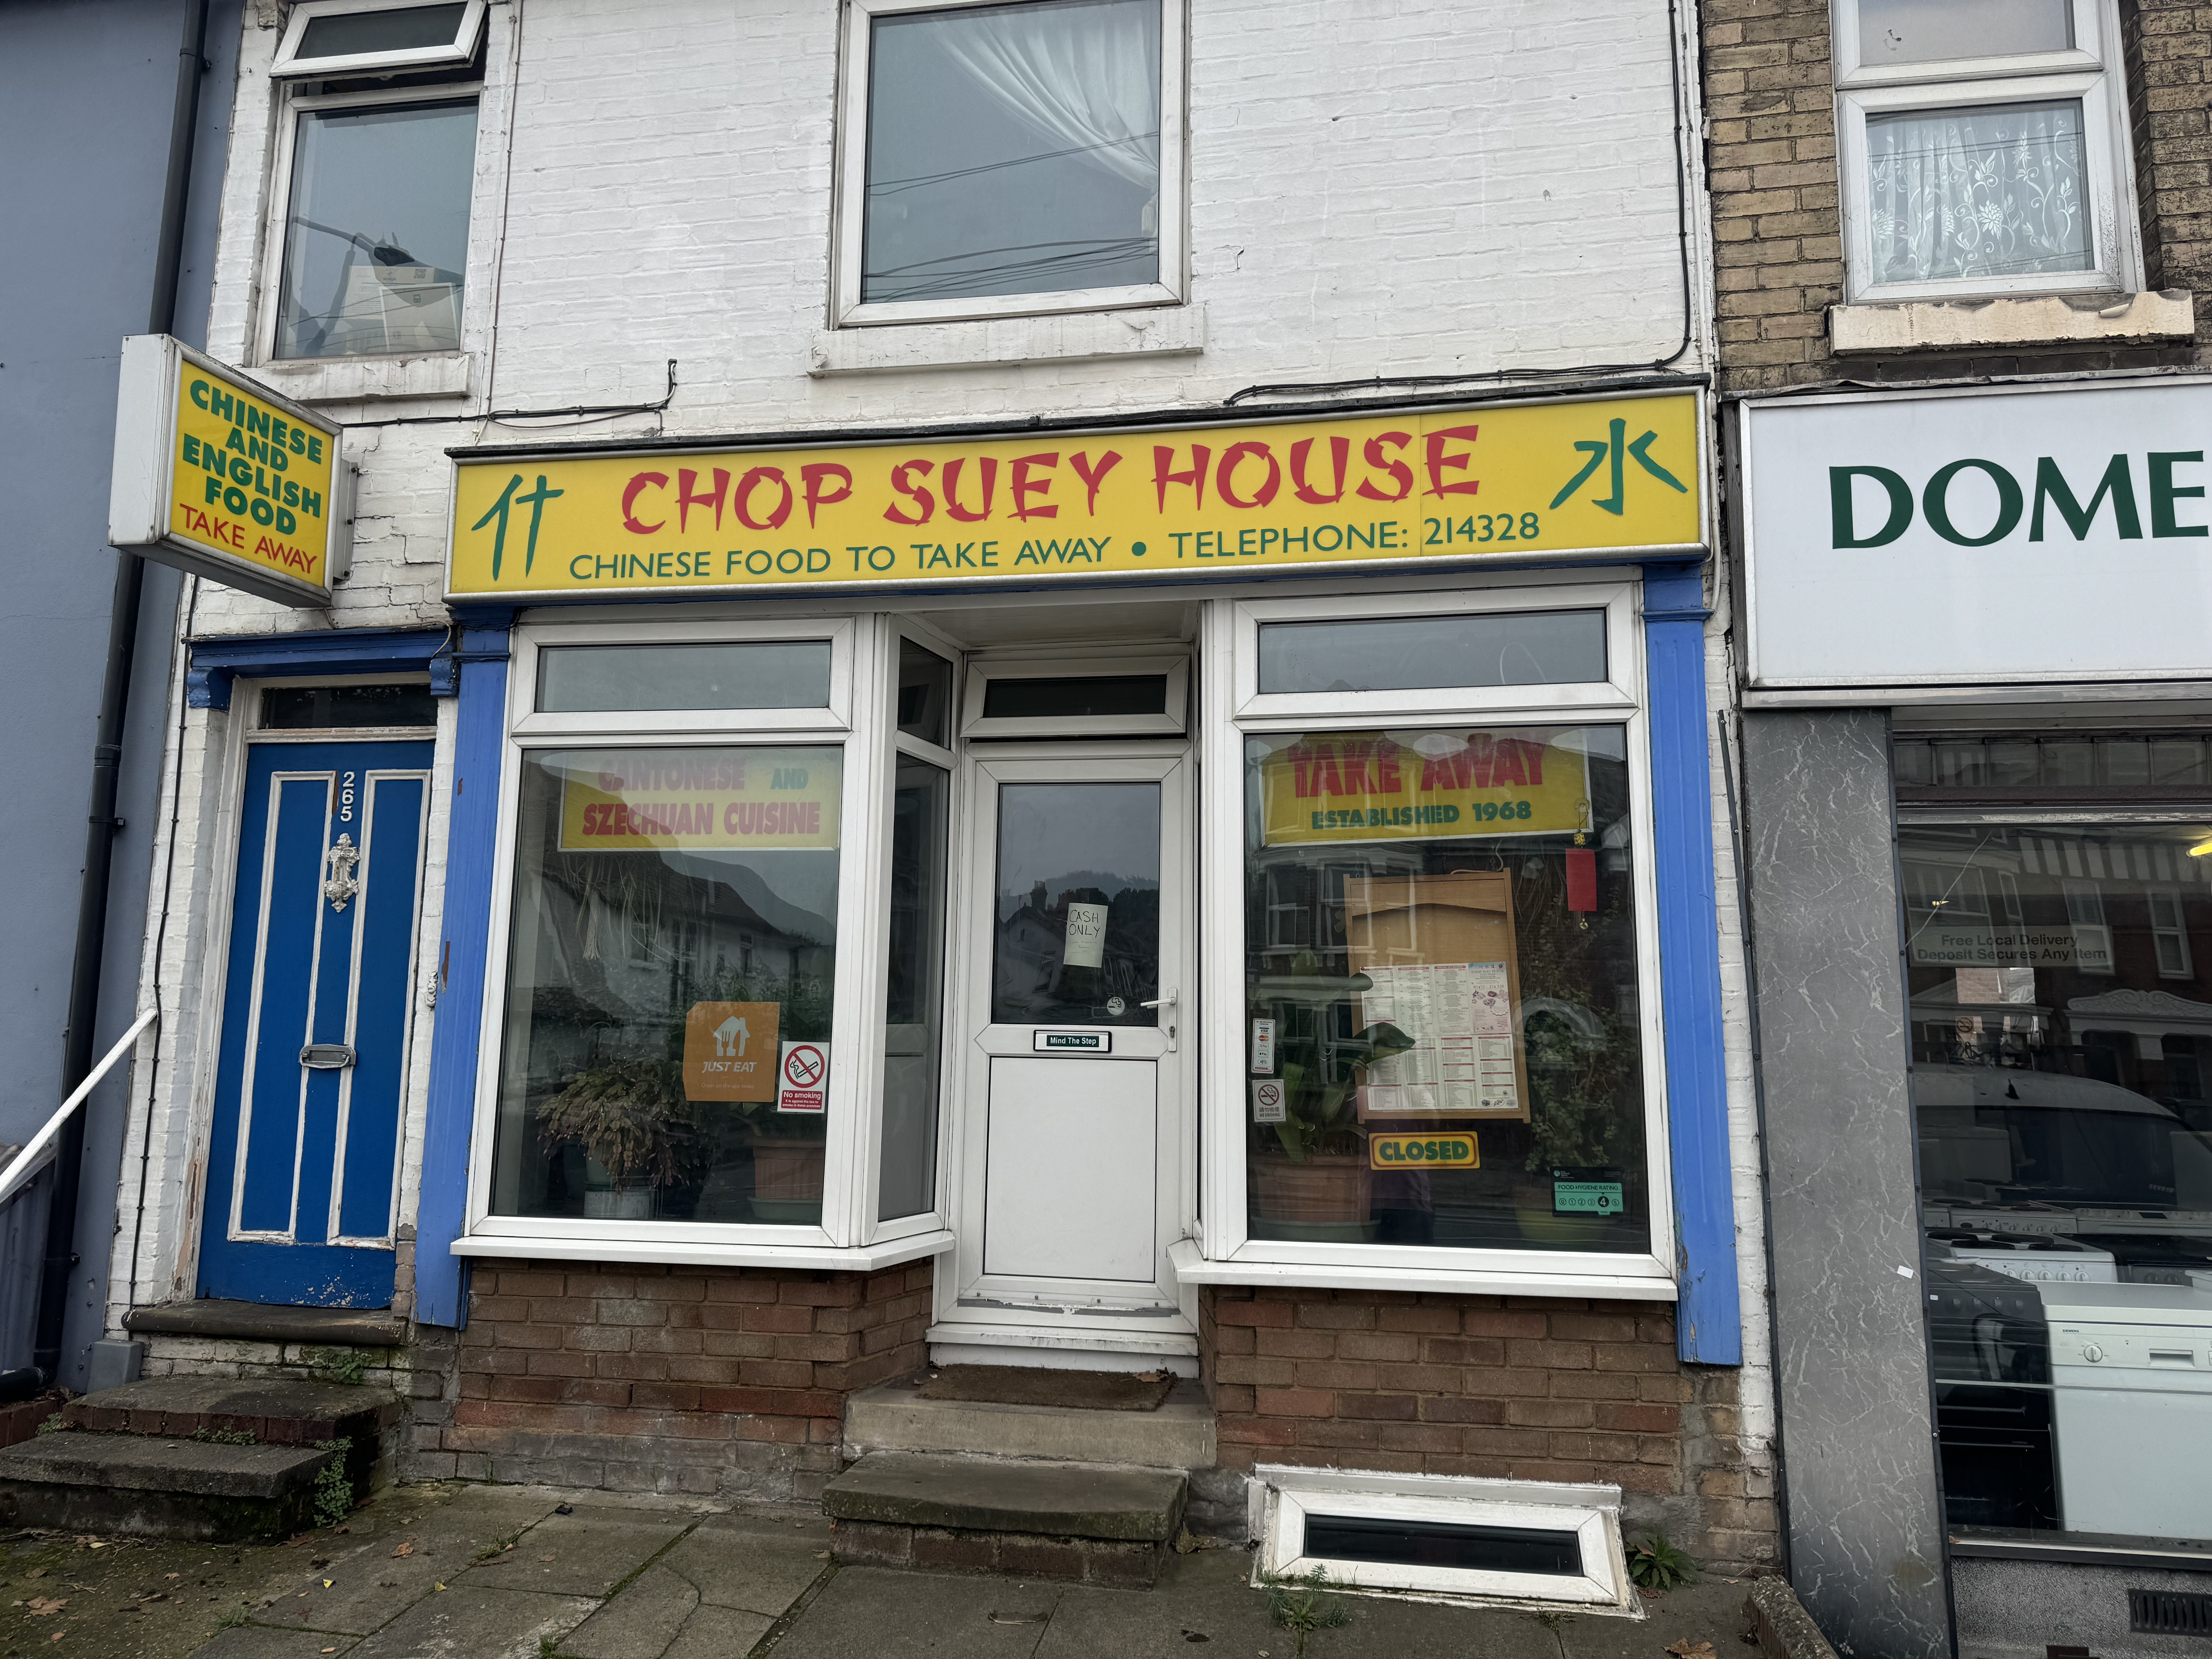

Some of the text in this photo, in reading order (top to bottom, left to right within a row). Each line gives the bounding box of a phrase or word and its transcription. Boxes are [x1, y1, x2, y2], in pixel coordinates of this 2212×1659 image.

[190, 380, 322, 464] CHINESE
[225, 427, 288, 471] AND
[182, 433, 321, 518] ENGLISH
[622, 425, 1479, 534] CHOP SUEY HOUSE
[1549, 418, 1688, 516] 水
[205, 476, 296, 535] FOOD
[1829, 450, 2209, 550] DOME
[180, 503, 317, 574] TAKE AWAY
[570, 512, 1540, 580] CHINESE FOOD TO TAKE AWAY TELEPHONE: 214328
[598, 758, 809, 792] CANTONESE AND
[1287, 735, 1546, 798] TAKE AWAY
[582, 802, 821, 835] SZECHUAN CUISINE
[1312, 801, 1532, 830] ESTABLISHED 1968
[1069, 909, 1099, 924] CASH
[1069, 924, 1100, 939] ONLY
[1918, 948, 2107, 962] Deposit Secures Any Item
[1942, 934, 2078, 947] Free Local Delivery
[1082, 1037, 1096, 1045] Step
[702, 1061, 757, 1073] JUST EAT
[795, 1092, 821, 1100] smoking
[1379, 1141, 1469, 1161] CLOSED
[1600, 1197, 1606, 1206] 4
